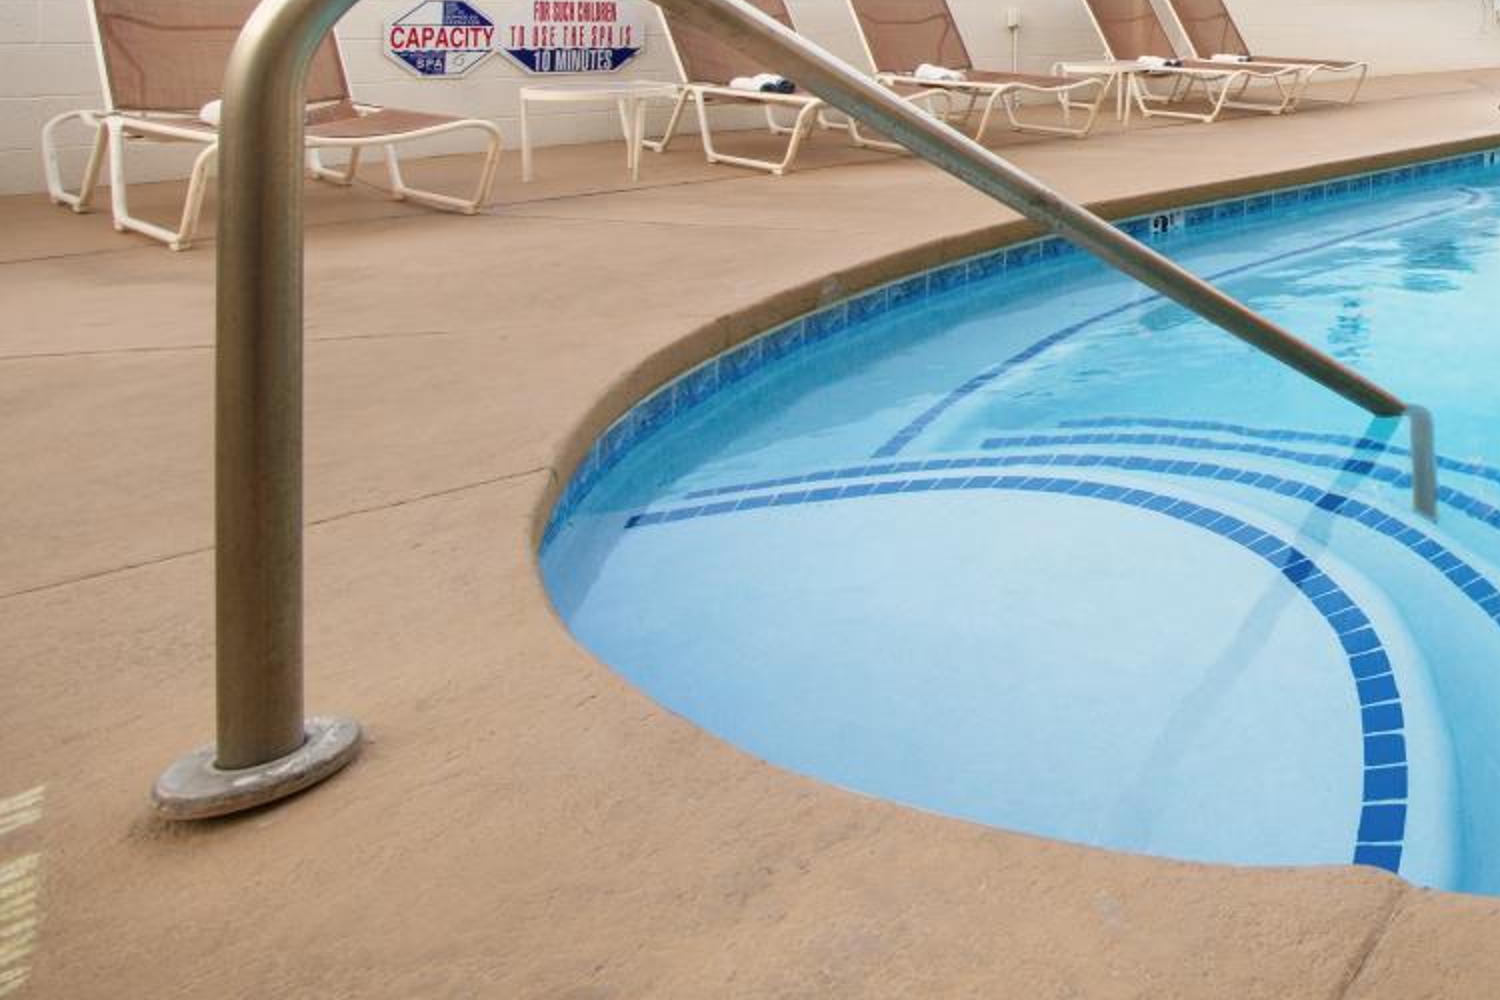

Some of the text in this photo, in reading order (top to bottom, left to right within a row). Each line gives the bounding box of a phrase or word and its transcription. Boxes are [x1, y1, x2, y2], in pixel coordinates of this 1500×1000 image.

[534, 0, 550, 20] FOR
[577, 1, 617, 22] CHILDREN
[390, 27, 495, 49] CAPACITY
[511, 25, 632, 47] TO USE THE SPA IS
[416, 57, 443, 71] SPA
[534, 50, 613, 71] 10 MINUTES
